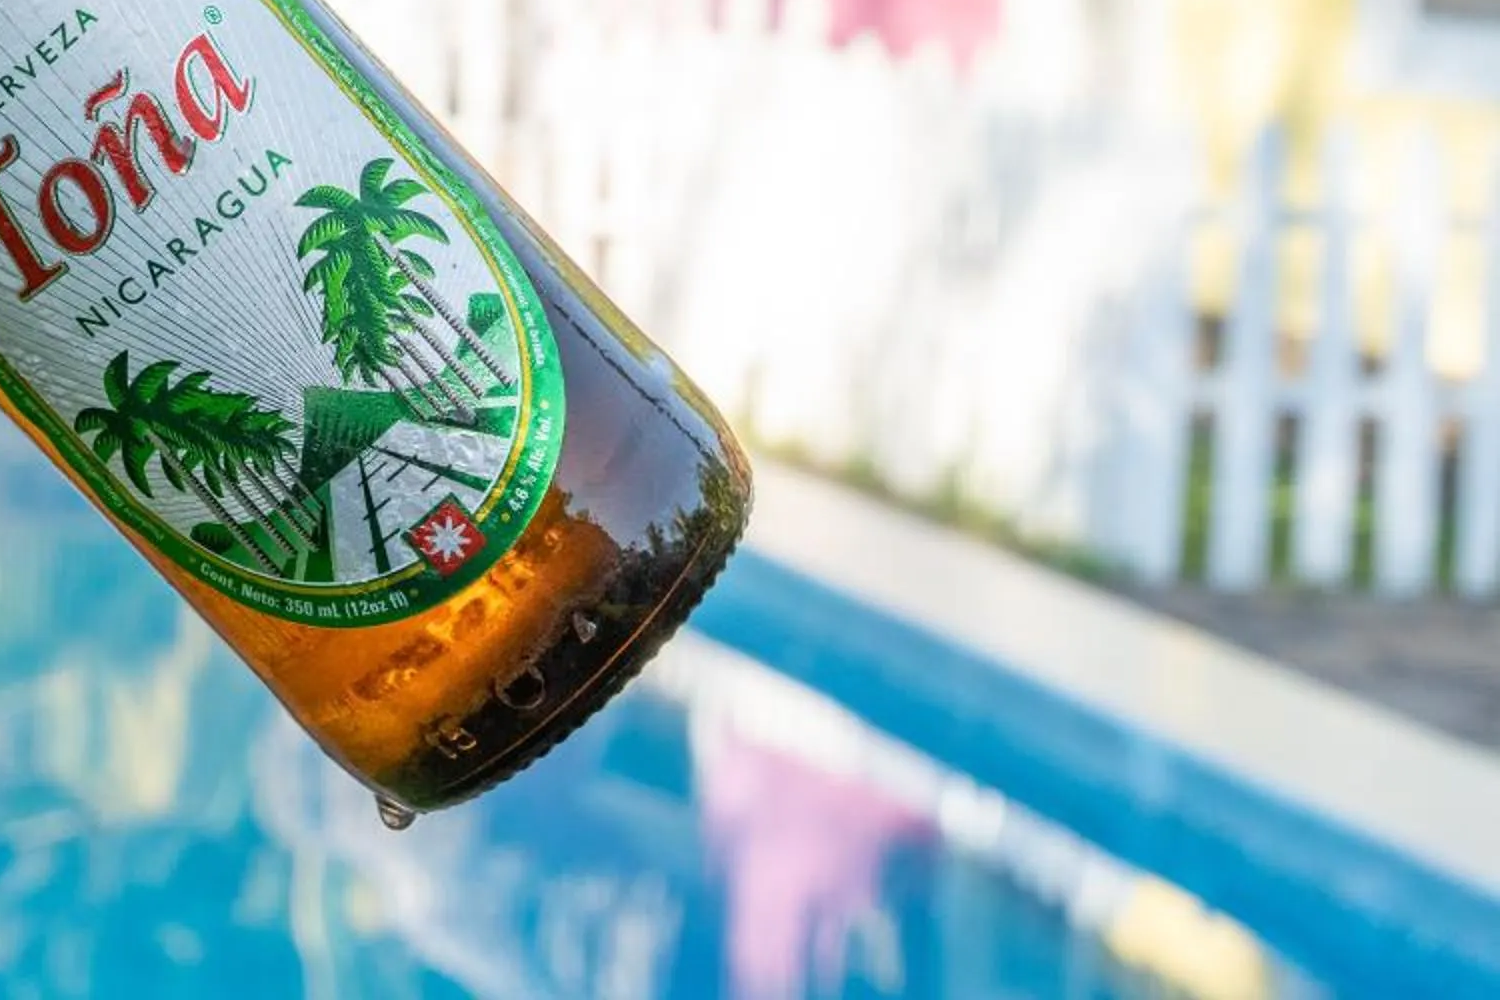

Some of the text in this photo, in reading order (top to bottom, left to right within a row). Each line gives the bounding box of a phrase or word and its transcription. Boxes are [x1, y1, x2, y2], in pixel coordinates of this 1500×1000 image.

[75, 149, 294, 337] NICARAGUA
[506, 486, 531, 514] 4.6
[196, 559, 240, 593] Cont.
[236, 581, 282, 609] Neto:
[282, 596, 313, 616] 350
[316, 601, 341, 617] mL
[343, 594, 389, 618] (12oz
